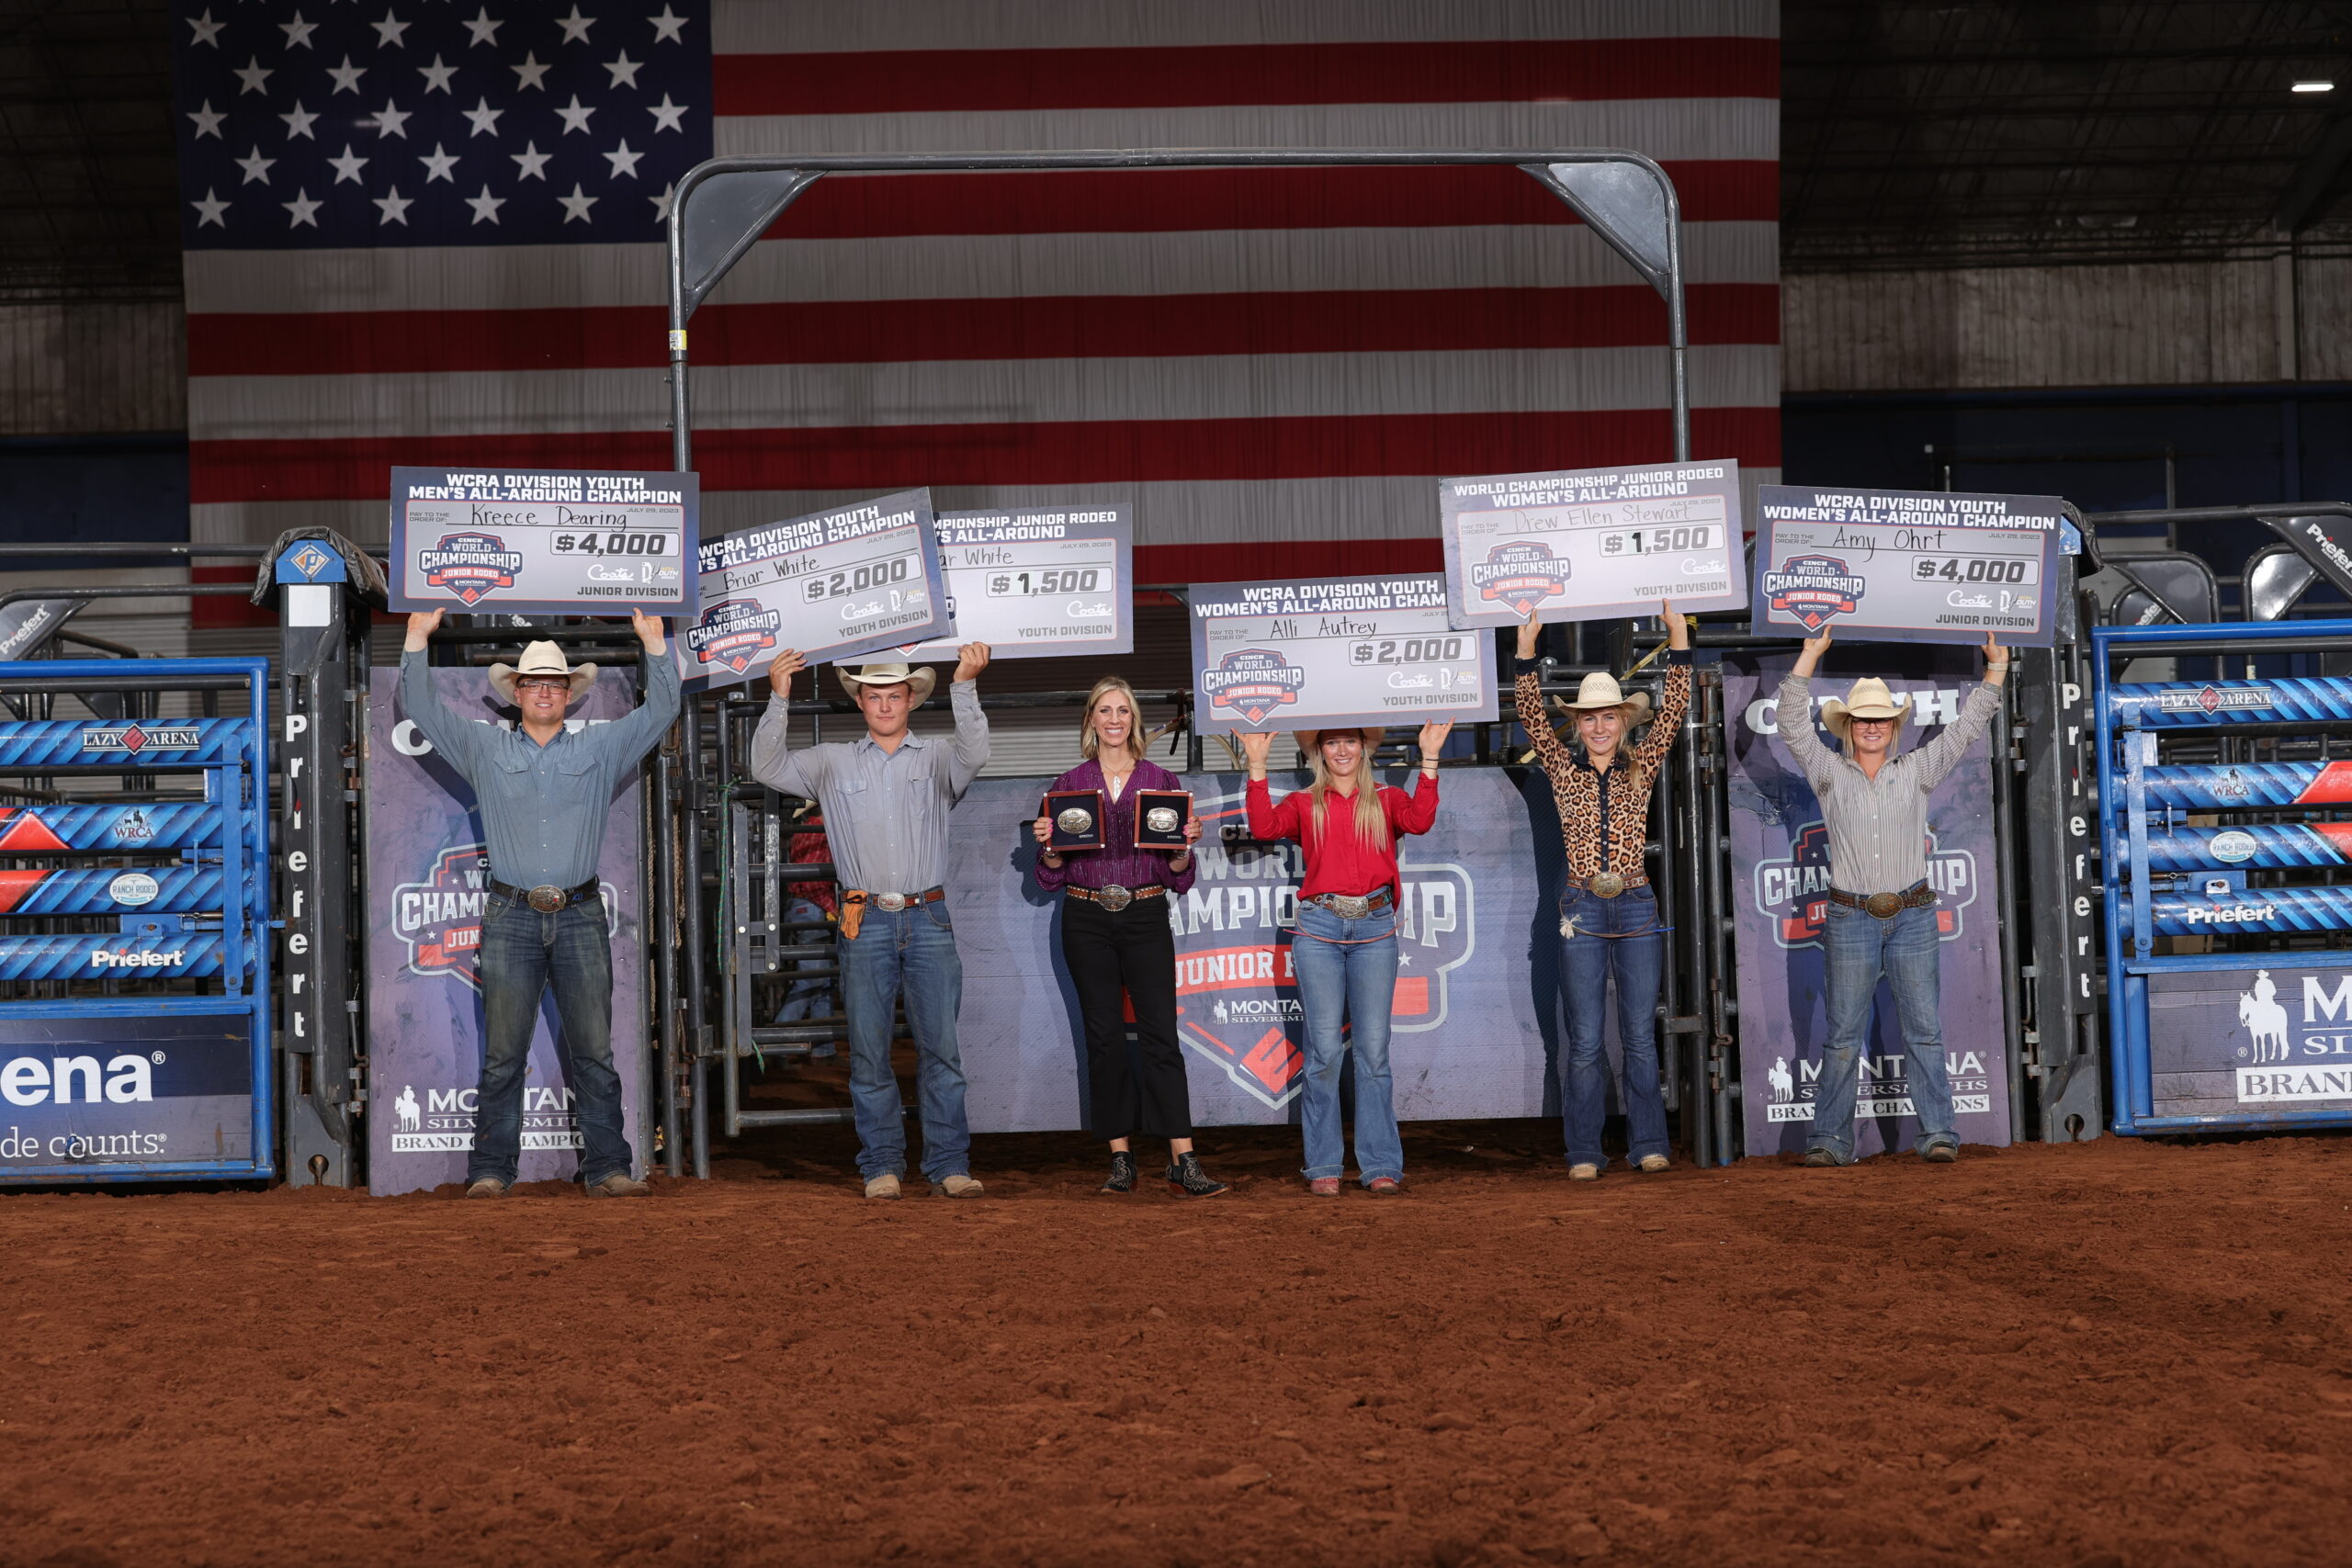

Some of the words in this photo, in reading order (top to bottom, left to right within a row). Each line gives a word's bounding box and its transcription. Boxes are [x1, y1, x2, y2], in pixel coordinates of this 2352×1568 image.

[447, 474, 500, 488] WCRA
[504, 475, 582, 490] DIVISION
[585, 477, 644, 491] YOUTH
[1454, 482, 1505, 496] WORLD
[1509, 475, 1618, 493] CHAMPIONSHIP
[1621, 471, 1673, 485] JUNIOR
[1677, 468, 1724, 480] RODEO
[469, 487, 582, 502] ALL-AROUND
[587, 490, 682, 503] CHAMPION
[1579, 481, 1688, 502] ALL-AROUND
[1815, 494, 1865, 509] WCRA
[1870, 497, 1945, 512] DIVISION
[1949, 500, 2006, 514] YOUTH
[471, 503, 538, 525] Kreece
[555, 505, 627, 533] Dearing
[1012, 513, 1065, 526] JUNIOR
[1069, 512, 1117, 524] RODEO
[1512, 510, 1558, 533] Drew
[1567, 507, 1612, 525] Ellen
[1623, 504, 1692, 523] Stewart
[1849, 509, 1959, 526] ALL-AROUND
[1963, 513, 2055, 530] CHAMPION
[698, 537, 746, 559] WCRA
[750, 519, 821, 547] DIVISION
[824, 505, 879, 529] YOUTH
[721, 533, 823, 567] ALL-AROUND
[827, 510, 916, 542] CHAMPION
[956, 525, 1066, 542] ALL-AROUND
[451, 543, 492, 553] WORLD
[1833, 525, 1876, 562] Amy
[1894, 528, 1947, 549] Ohrt
[422, 552, 521, 570] CHAMPIONSHIP
[965, 547, 1013, 565] White
[1501, 552, 1540, 563] WORLD
[443, 569, 471, 578] JUNIOR
[474, 569, 499, 578] RODEO
[724, 570, 763, 591] Briar
[773, 555, 820, 577] White
[1473, 559, 1568, 584] CHAMPIONSHIP
[1796, 566, 1836, 576] WORLD
[577, 586, 622, 596] JUNIOR
[626, 587, 678, 597] DIVISION
[1243, 587, 1295, 601] WCRA
[1300, 582, 1375, 599] DIVISION
[1381, 580, 1438, 594] YOUTH
[1496, 581, 1523, 590] JUNIOR
[1525, 579, 1549, 588] RODEO
[1634, 585, 1673, 596] YOUTH
[1676, 581, 1727, 593] DIVISION
[1767, 574, 1863, 595] CHAMPIONSHIP
[1283, 595, 1391, 613] ALL-AROUND
[1787, 592, 1815, 601] JUNIOR
[1817, 593, 1841, 603] RODEO
[713, 607, 750, 623] WORLD
[839, 621, 876, 637] YOUTH
[879, 610, 928, 628] DIVISION
[1936, 615, 1979, 625] JUNIOR
[1984, 615, 2034, 626] DIVISION
[689, 612, 778, 649] CHAMPIONSHIP
[1018, 627, 1057, 637] YOUTH
[1061, 625, 1112, 636] DIVISION
[1270, 618, 1297, 638] Alli
[1318, 615, 1376, 639] Autrey
[710, 637, 736, 651] JUNIOR
[738, 633, 762, 644] RODEO
[1234, 660, 1273, 670] WORLD
[1205, 669, 1302, 691] CHAMPIONSHIP
[1228, 687, 1255, 697] JUNIOR
[1257, 687, 1282, 695] RODEO
[1383, 695, 1422, 705] YOUTH
[1426, 693, 1478, 704] DIVISION
[2161, 694, 2196, 706] LAZY
[2225, 693, 2272, 705] ARENA
[84, 734, 120, 746] LAZY
[152, 732, 199, 745] ARENA
[2212, 785, 2250, 796] WRCA
[114, 827, 154, 838] WRCA
[2062, 683, 2090, 998] Priefert
[285, 715, 309, 1038] Priefert
[136, 886, 156, 894] RODEO
[2188, 905, 2275, 924] Priefert
[92, 948, 185, 967] Priefert
[1175, 952, 1274, 988] JUNIOR
[396, 1136, 463, 1149] BRAND
